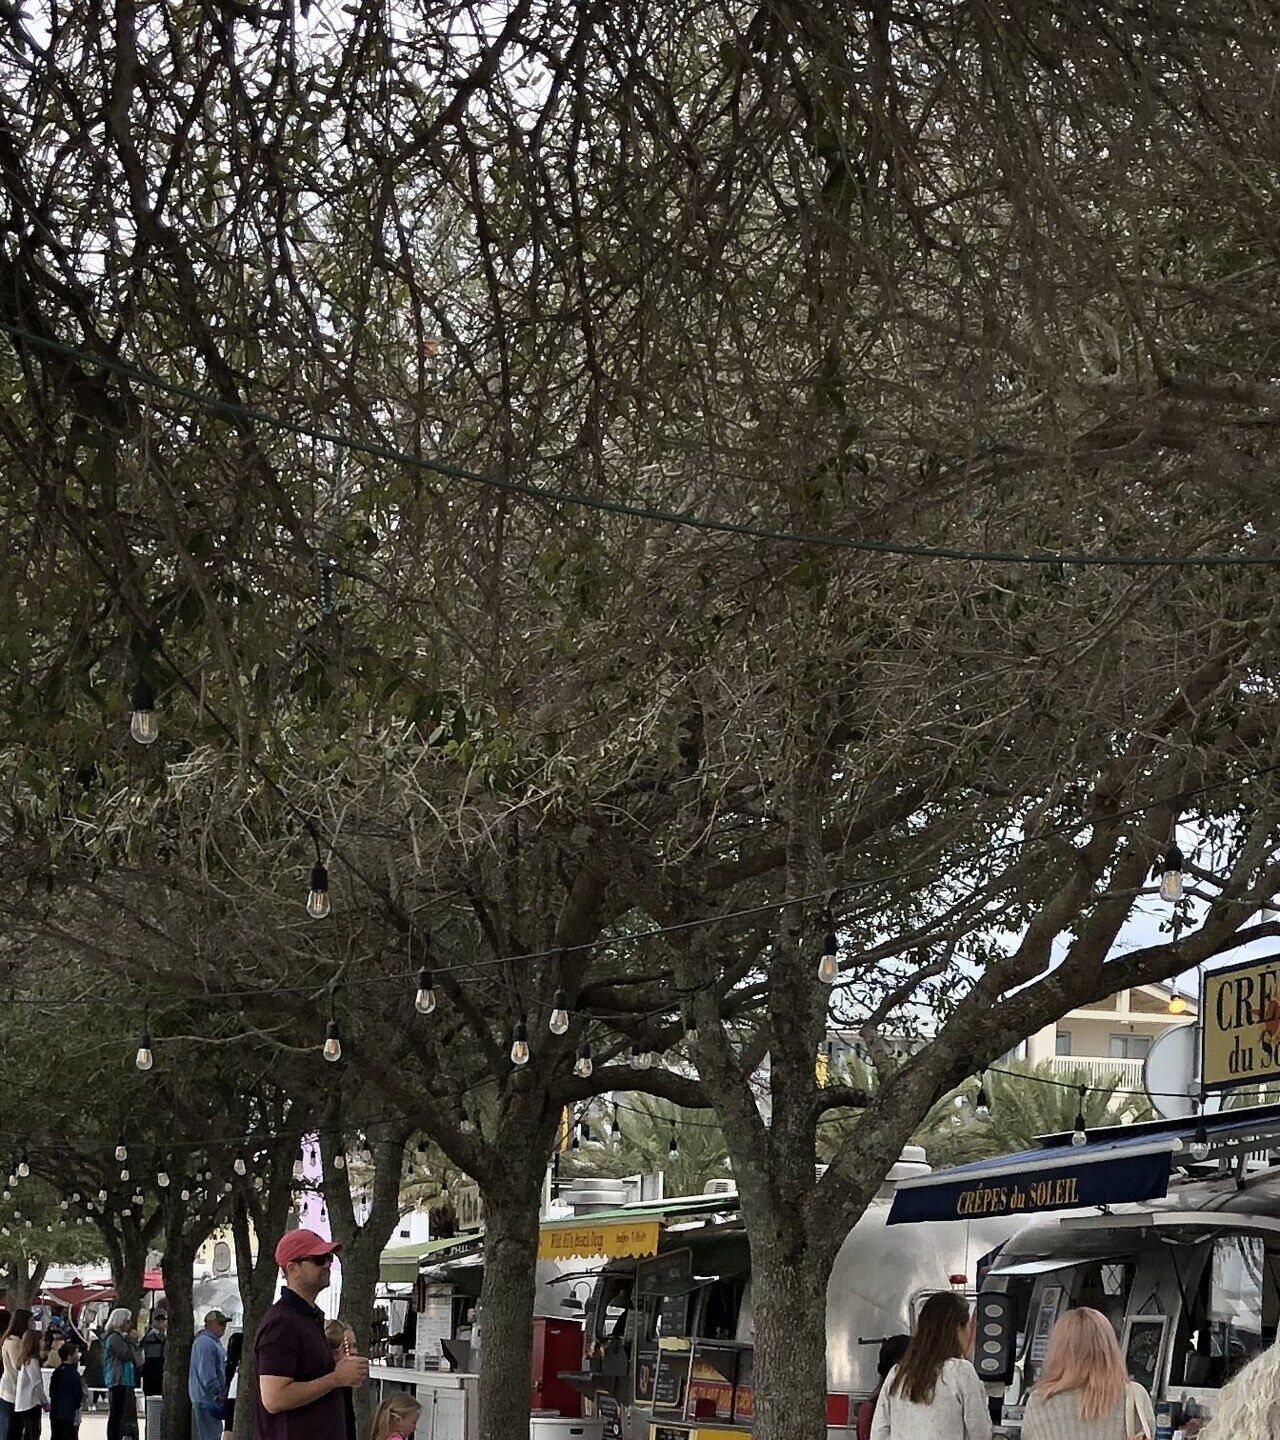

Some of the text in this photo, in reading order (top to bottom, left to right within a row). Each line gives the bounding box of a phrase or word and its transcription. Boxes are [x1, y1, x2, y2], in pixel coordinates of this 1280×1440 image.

[1228, 1036, 1254, 1074] du
[1010, 1185, 1026, 1209] du
[1029, 1177, 1079, 1207] SOLEIL
